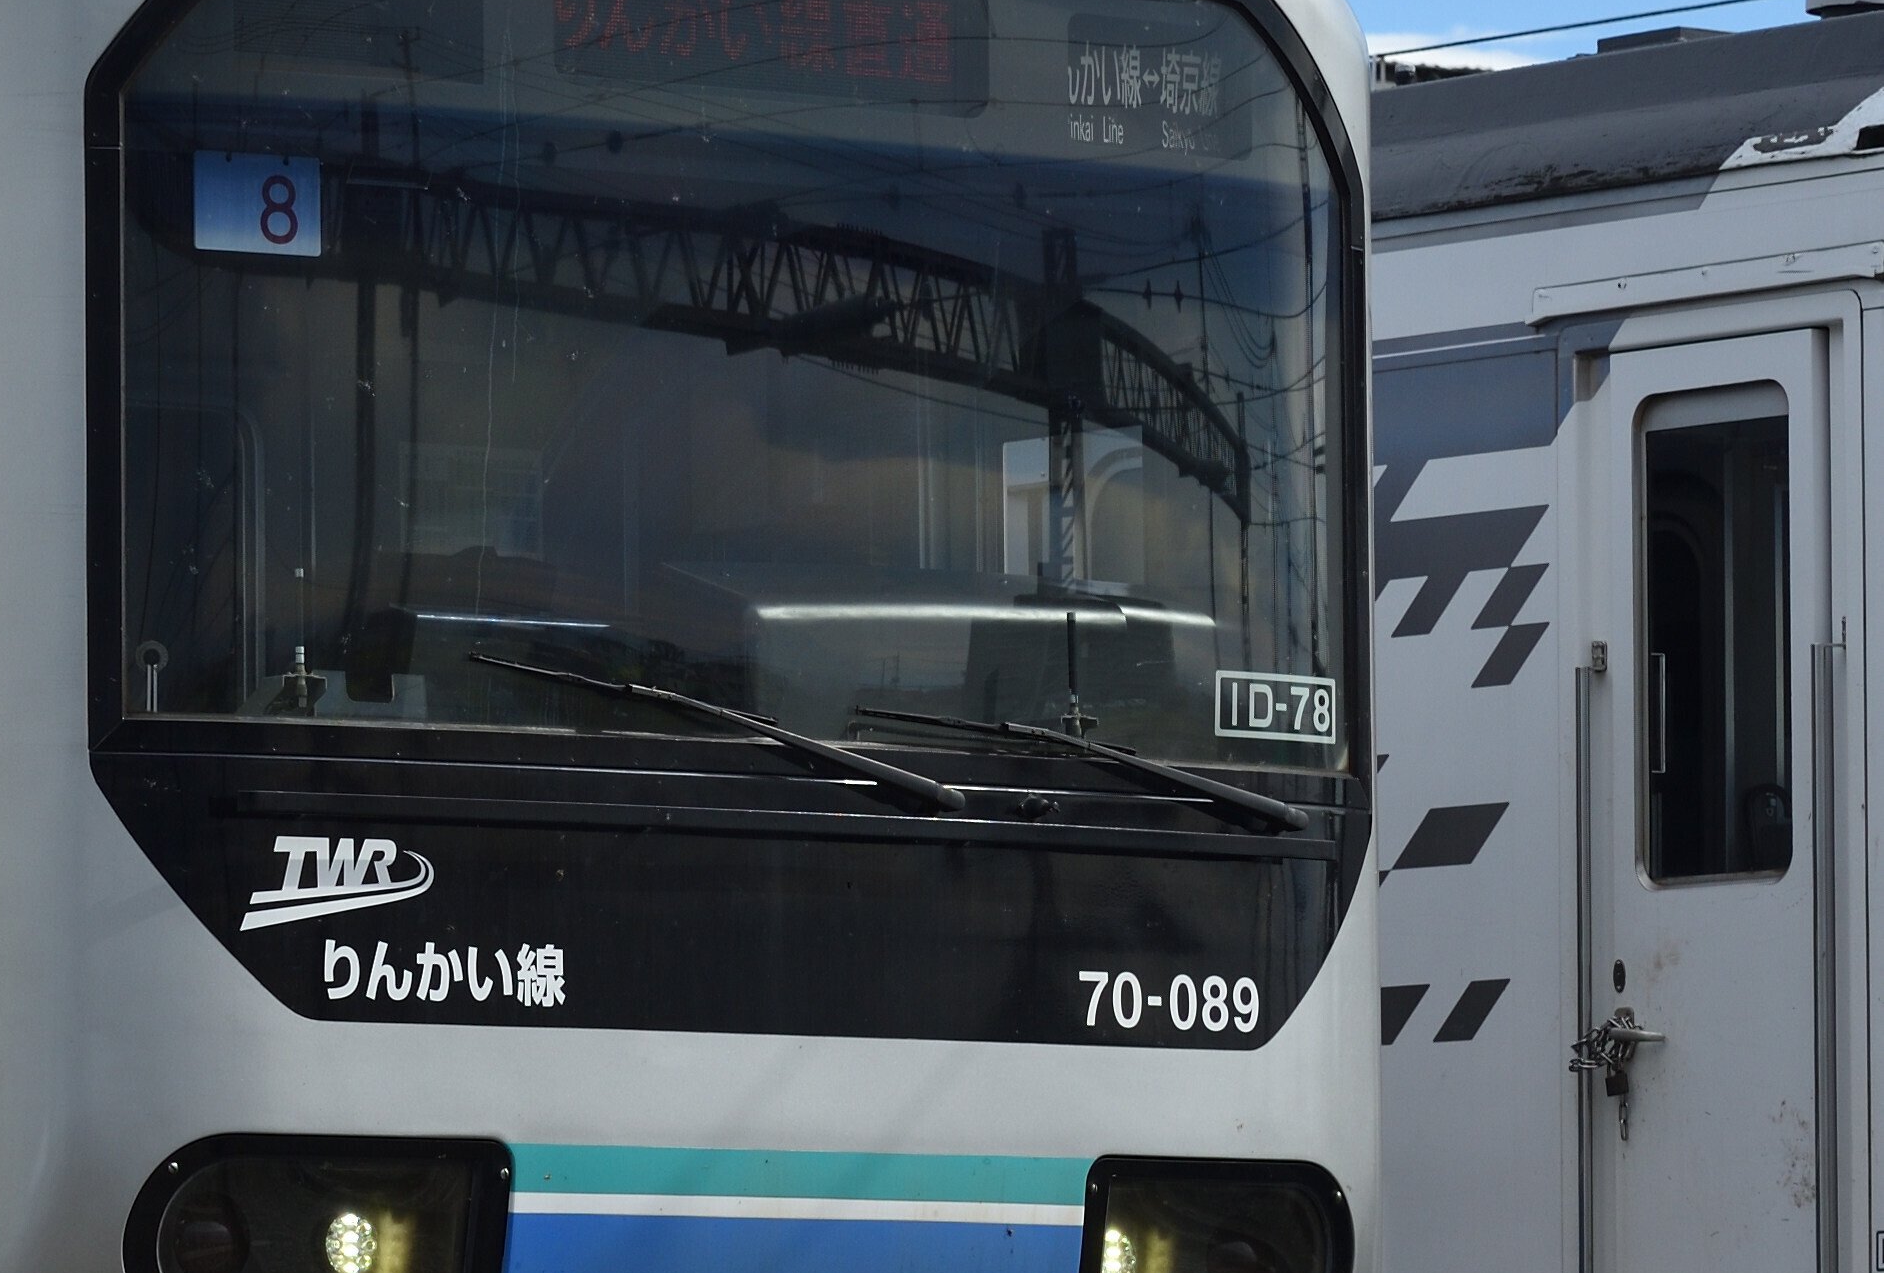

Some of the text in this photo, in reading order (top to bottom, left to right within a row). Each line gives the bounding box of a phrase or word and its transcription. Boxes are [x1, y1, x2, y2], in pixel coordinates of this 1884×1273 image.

[1069, 113, 1094, 143] inkai
[1102, 114, 1125, 145] Line
[259, 174, 299, 245] 8
[1229, 680, 1332, 735] ID-78
[322, 938, 567, 1008] りんかい線
[1077, 969, 1261, 1034] 70-089
